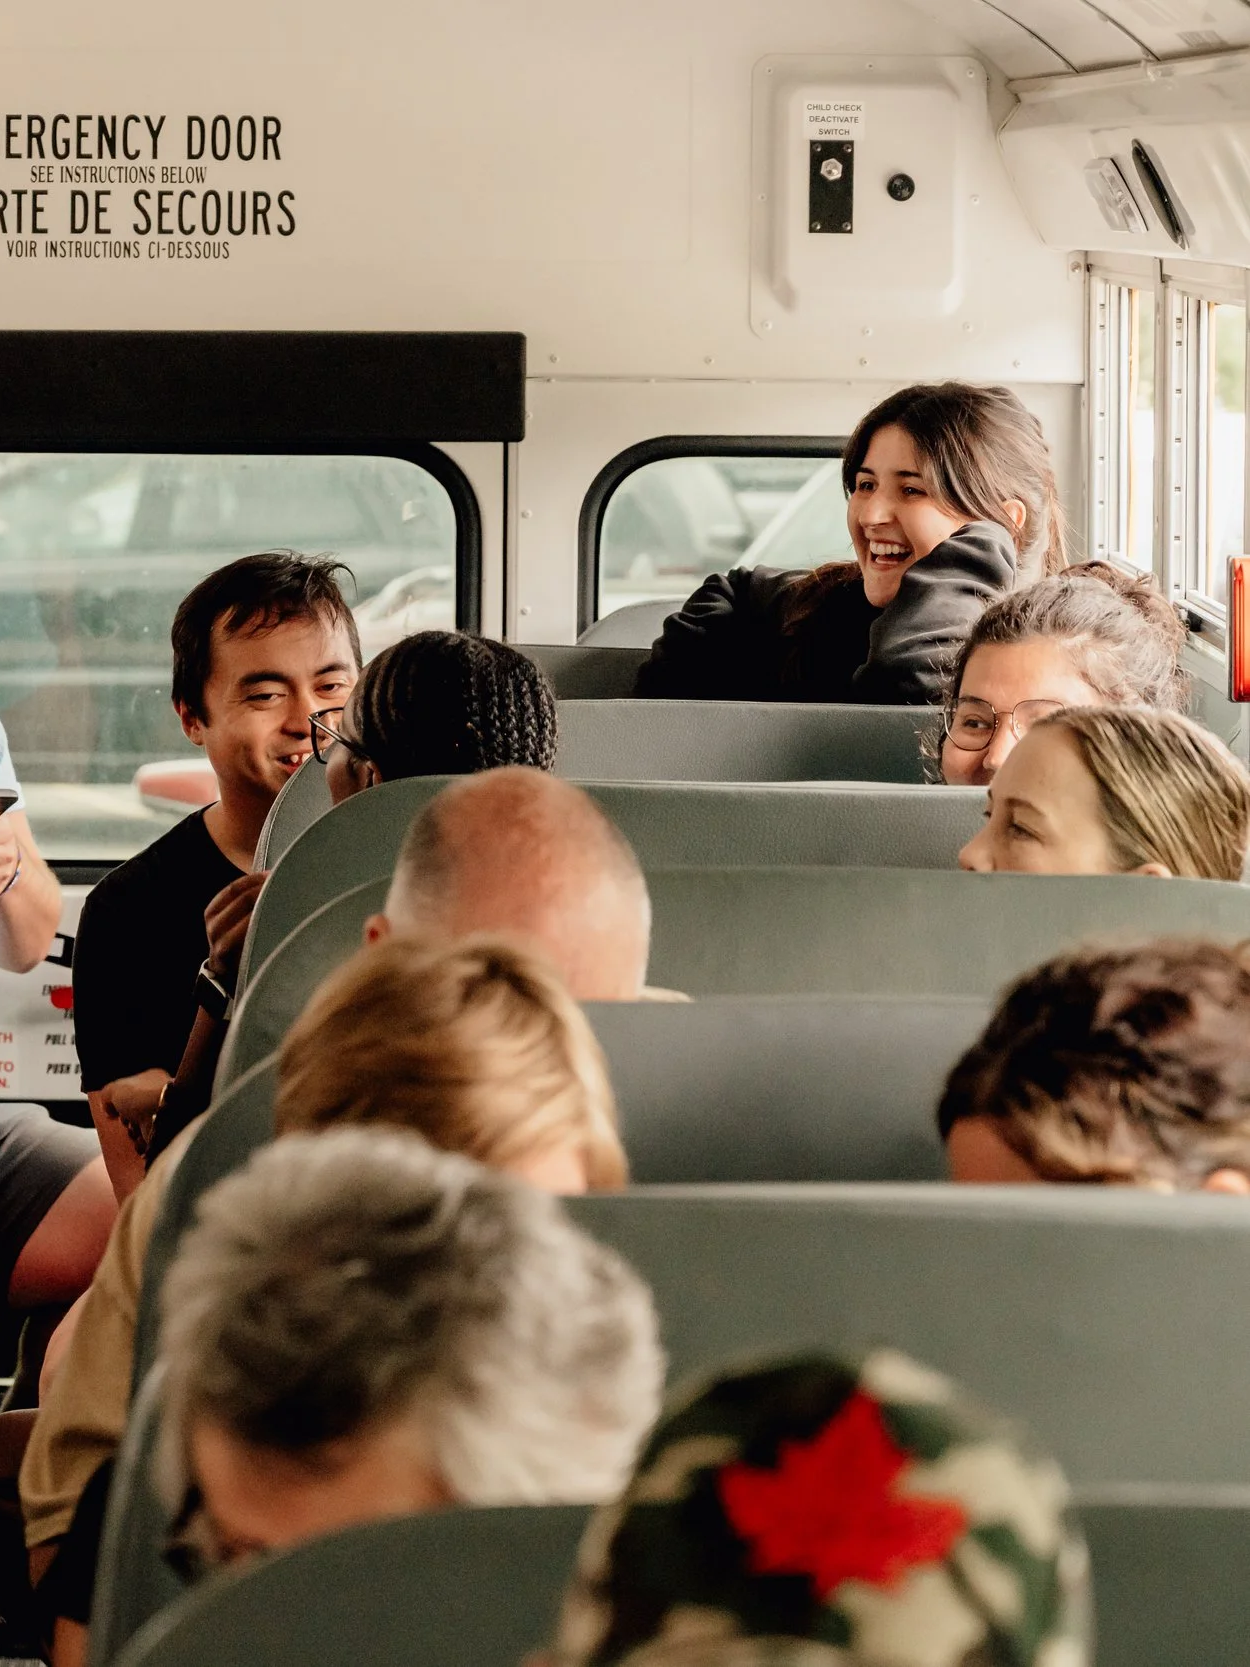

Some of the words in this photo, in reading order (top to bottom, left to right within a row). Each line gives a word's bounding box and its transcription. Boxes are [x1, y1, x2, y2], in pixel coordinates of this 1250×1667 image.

[807, 103, 831, 112] CHILD
[833, 104, 862, 112] CHECK
[808, 115, 859, 124] DEACTIVATE
[186, 114, 282, 161] DOOR
[818, 127, 850, 136] SWITCH
[30, 165, 54, 183] SEE
[60, 165, 156, 184] INSTRUCTIONS
[161, 166, 208, 184] BELOW
[70, 189, 112, 235] DE
[133, 188, 296, 236] SECOURS
[6, 240, 38, 258] VOIR
[45, 240, 141, 259] INSTRUCTIONS
[148, 240, 230, 260] CI-DESSOUS
